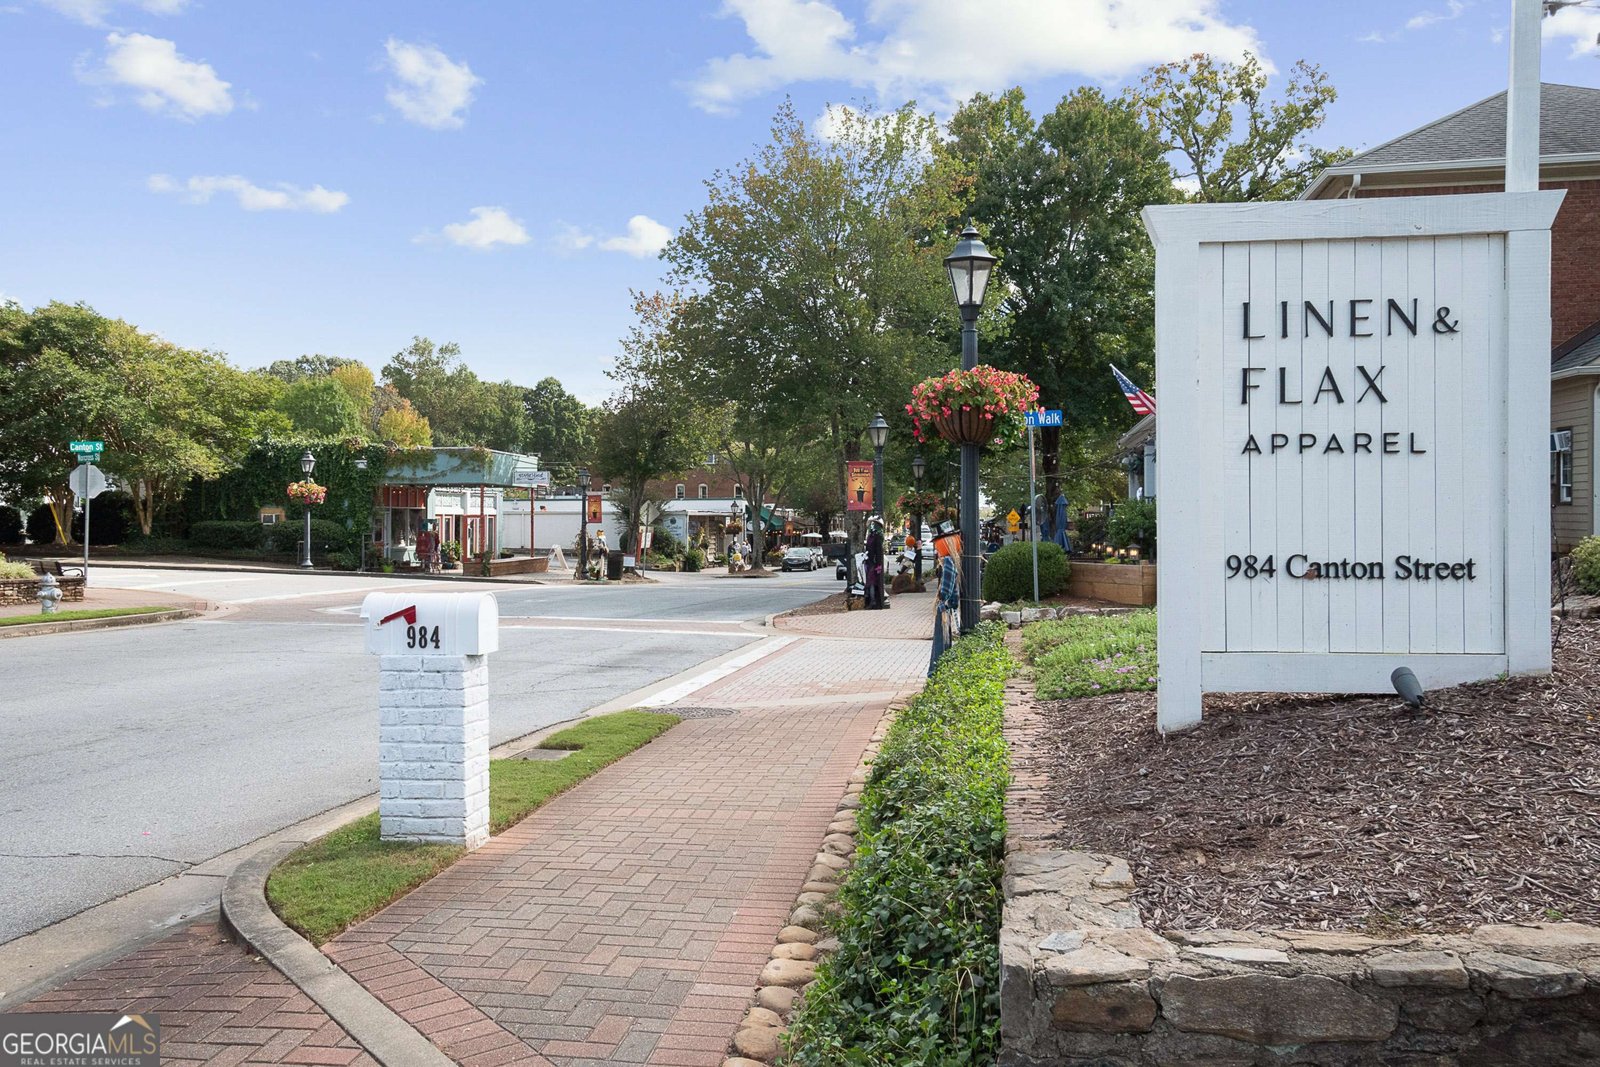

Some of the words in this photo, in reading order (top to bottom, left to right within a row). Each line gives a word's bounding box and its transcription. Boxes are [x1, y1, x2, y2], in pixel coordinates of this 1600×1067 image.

[1241, 365, 1388, 405] FLAX
[1037, 411, 1061, 425] Walk
[70, 443, 94, 452] Canton
[95, 443, 103, 451] St
[1241, 432, 1427, 455] APPAREL
[1226, 555, 1277, 579] 984
[1286, 554, 1385, 580] Canton
[1395, 555, 1477, 580] Street
[406, 625, 441, 649] 984
